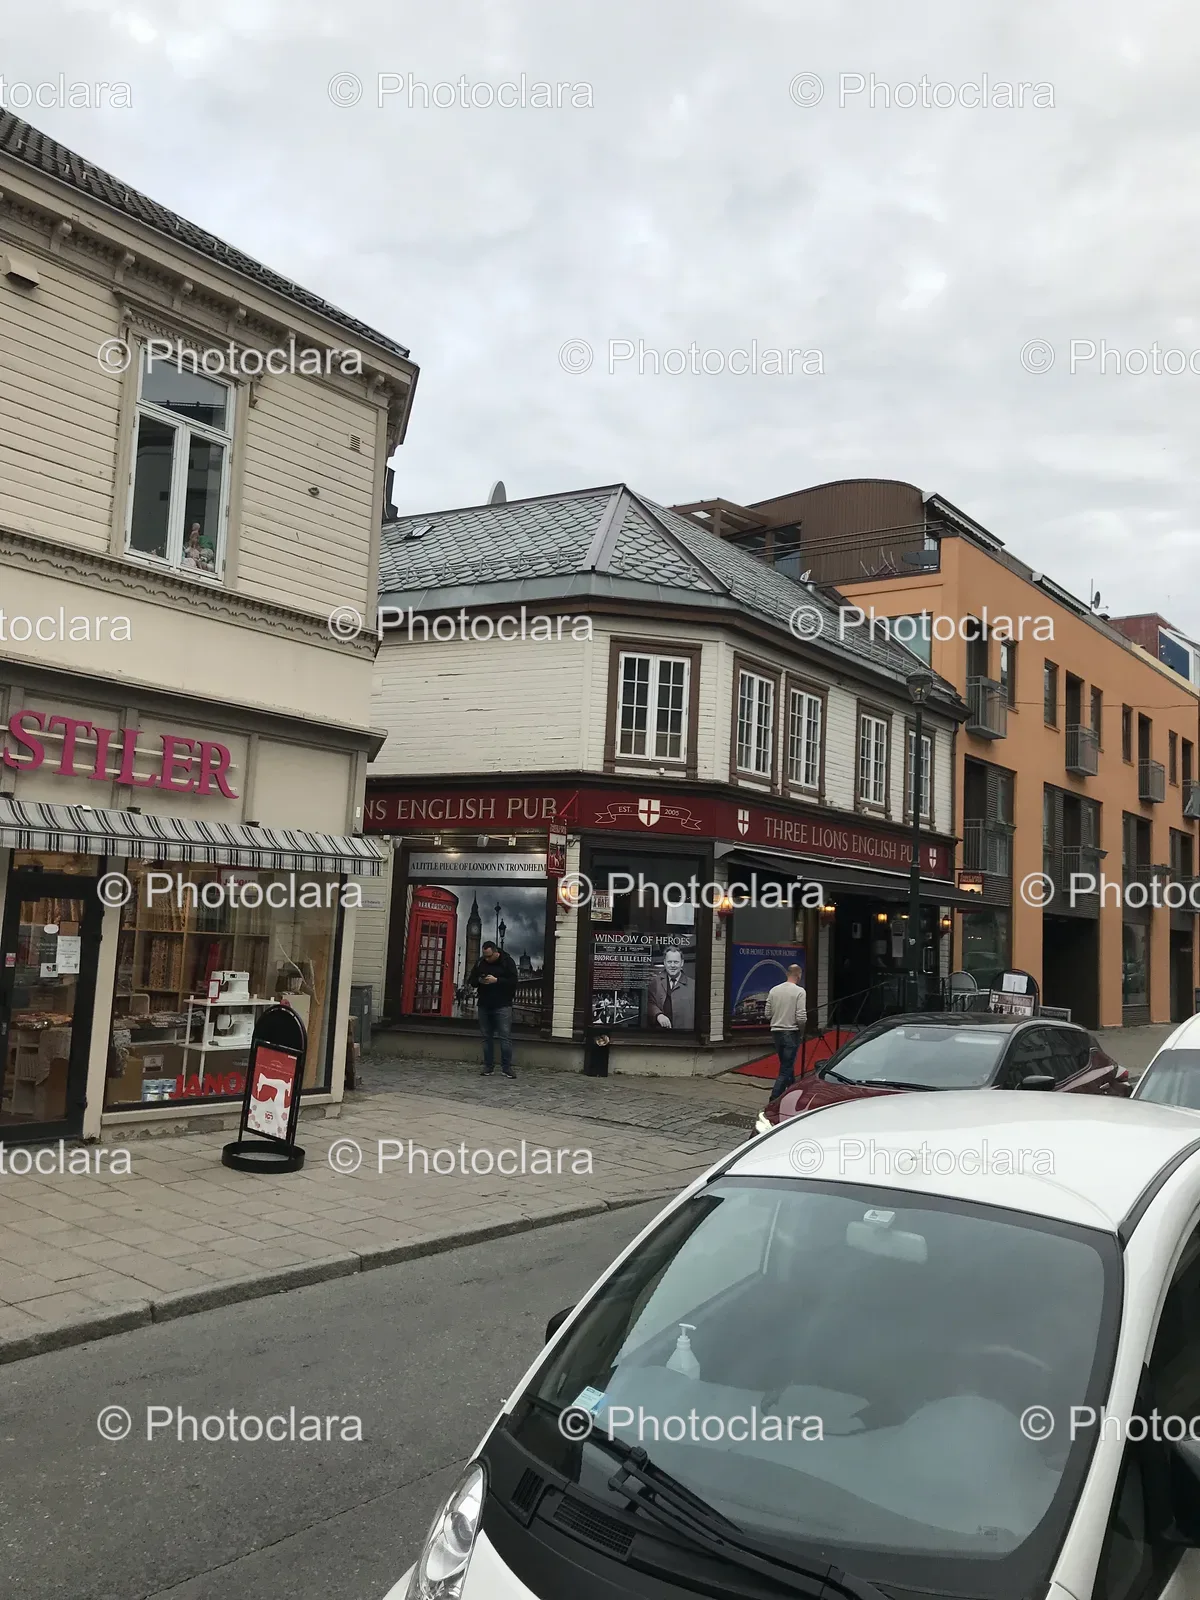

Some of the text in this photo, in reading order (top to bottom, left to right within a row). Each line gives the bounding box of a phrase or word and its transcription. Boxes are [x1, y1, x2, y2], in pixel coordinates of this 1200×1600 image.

[3, 710, 239, 799] STILER
[397, 798, 495, 820] ENGLISH
[507, 797, 557, 819] PUB
[664, 808, 680, 817] 2005
[764, 816, 921, 866] THREE LIONS ENGLISH PU
[410, 862, 416, 870] A
[416, 862, 439, 870] LITTLE
[439, 862, 460, 871] PIECE
[460, 862, 469, 870] OF
[469, 862, 497, 871] LONDON
[498, 863, 505, 871] IN
[595, 934, 690, 946] WINDOW OF HEROES
